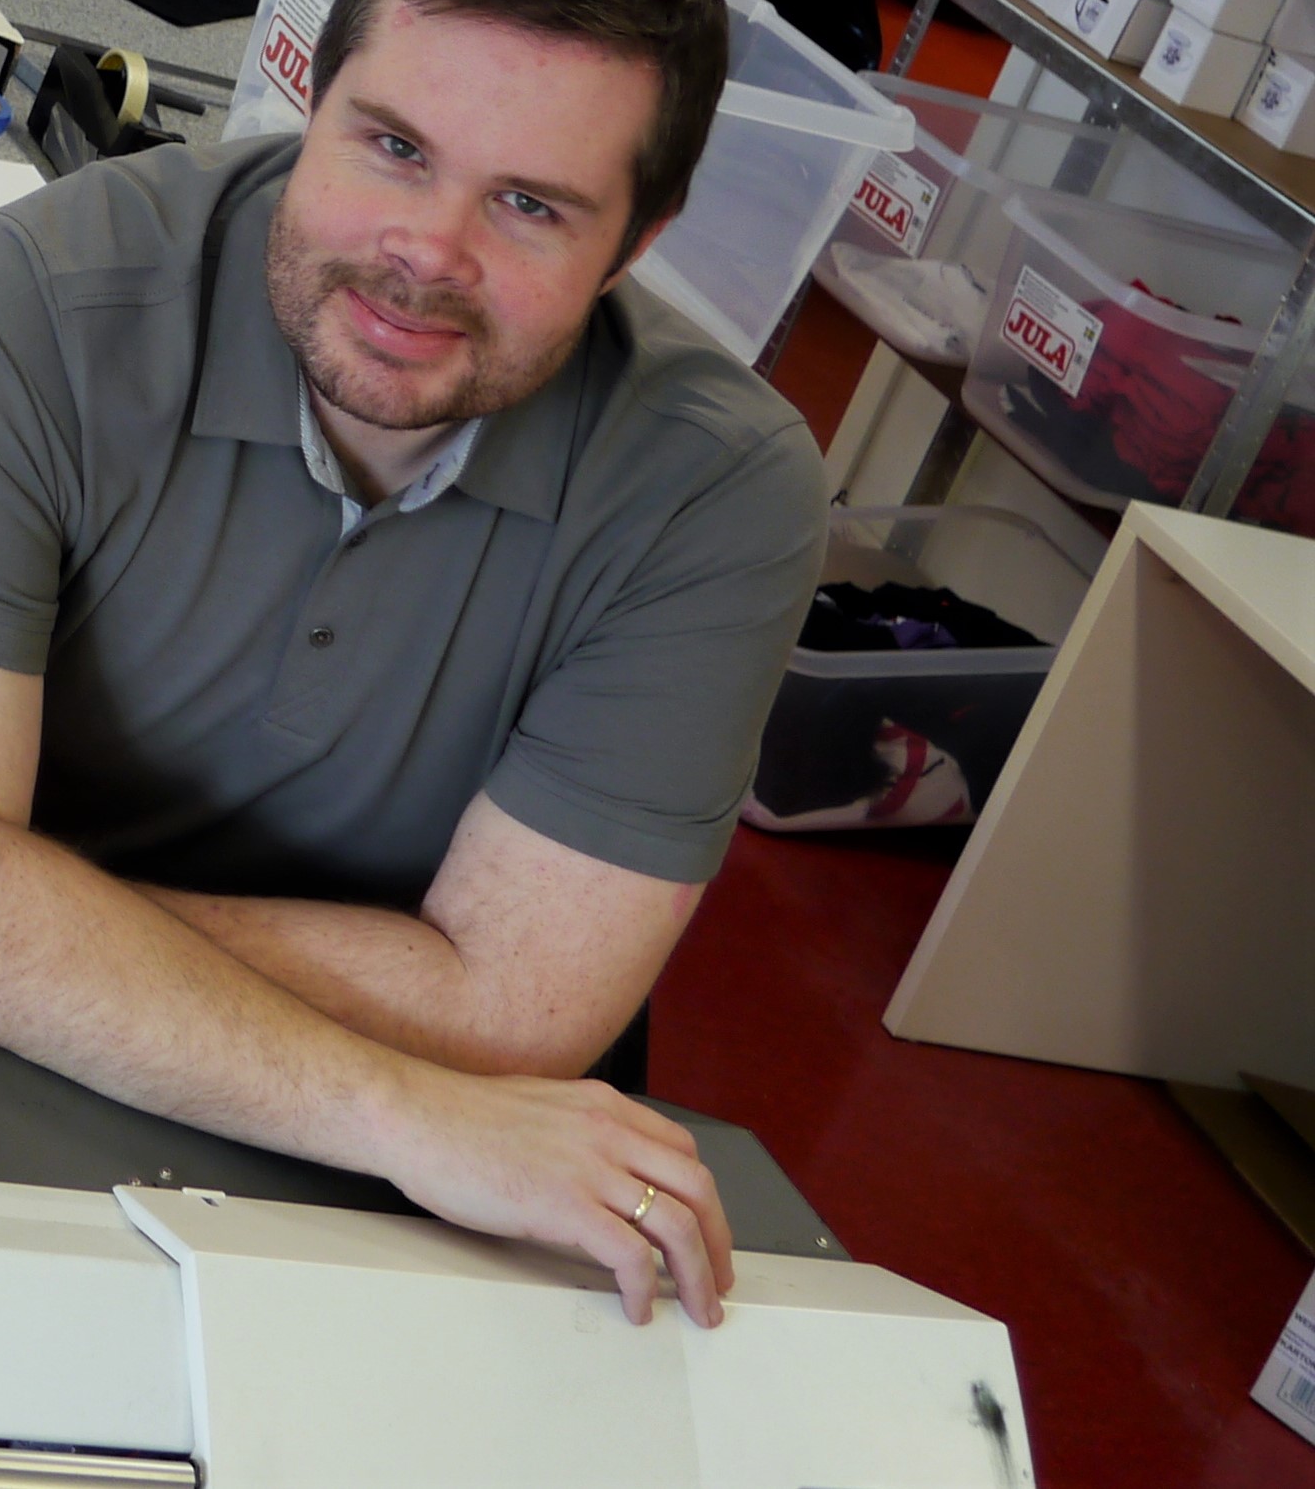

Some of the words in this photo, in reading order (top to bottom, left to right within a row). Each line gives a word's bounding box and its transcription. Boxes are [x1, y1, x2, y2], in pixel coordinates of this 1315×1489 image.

[265, 30, 310, 100] JUL
[854, 177, 906, 236] JULA
[1007, 310, 1068, 372] JULA
